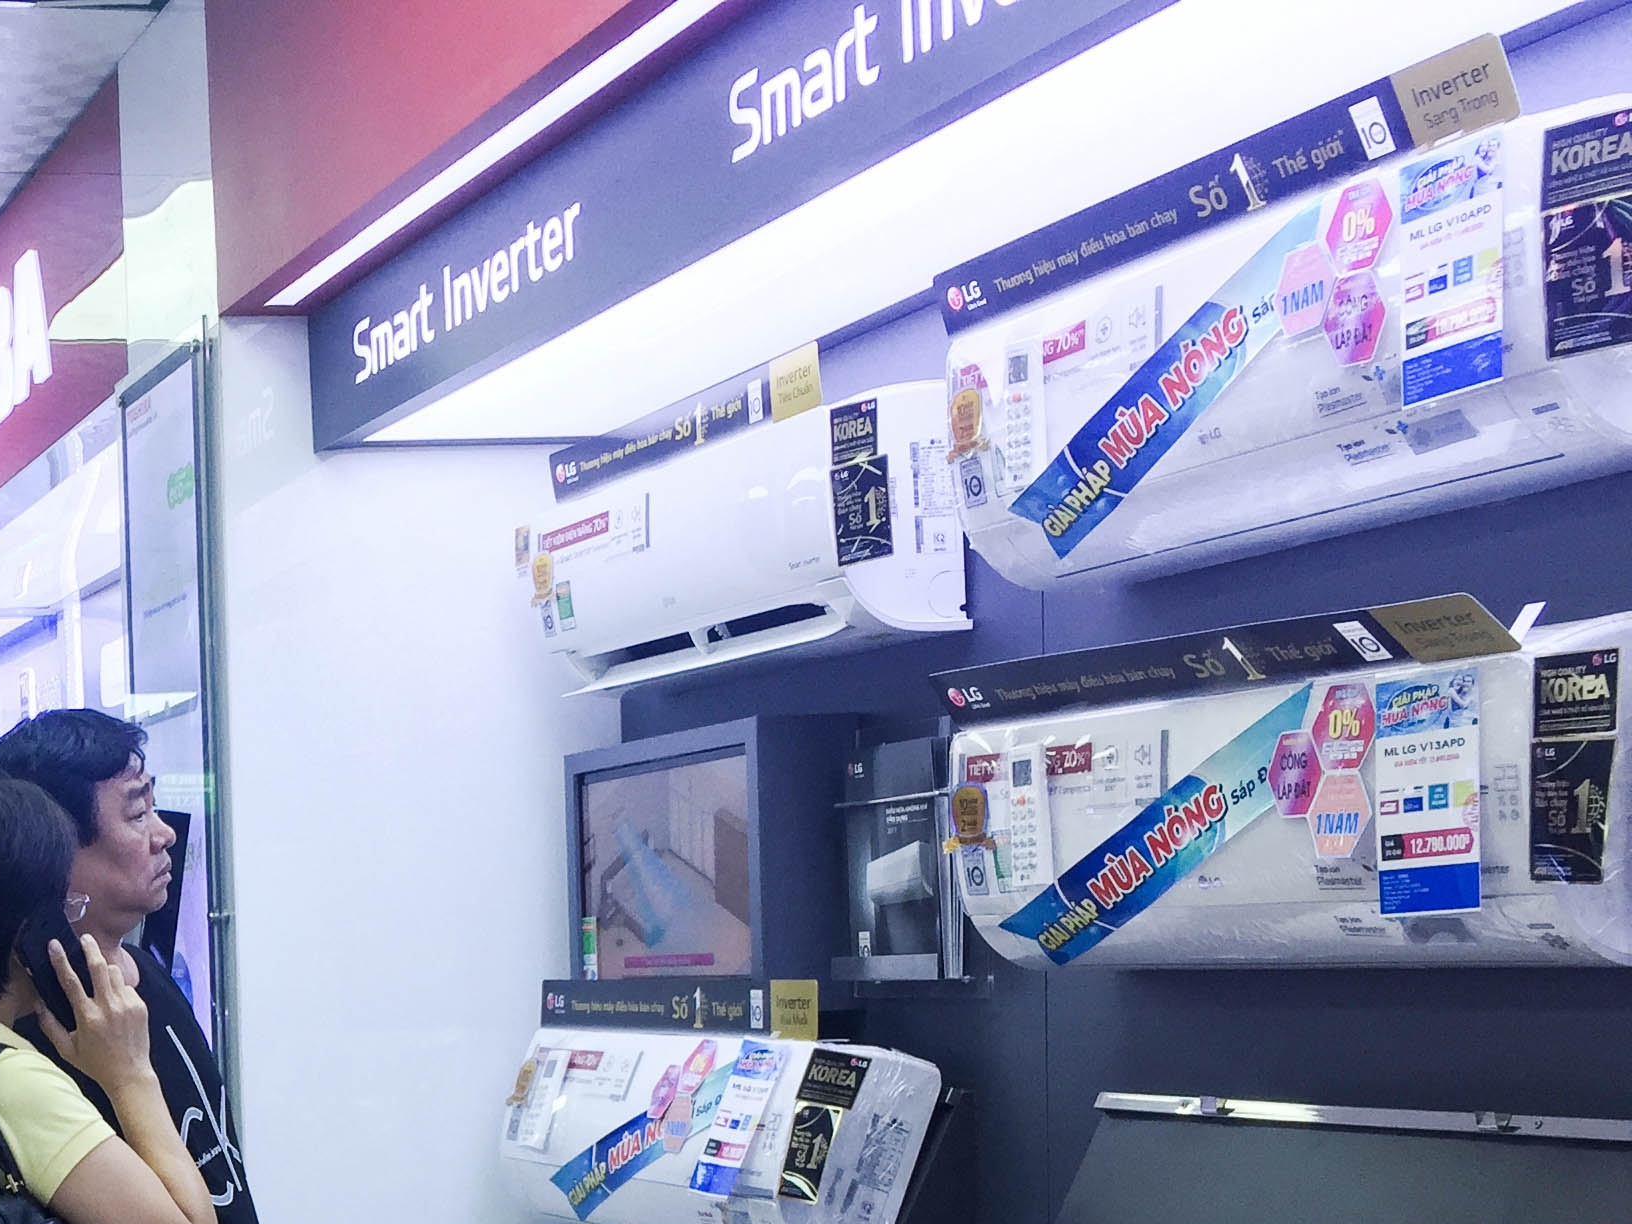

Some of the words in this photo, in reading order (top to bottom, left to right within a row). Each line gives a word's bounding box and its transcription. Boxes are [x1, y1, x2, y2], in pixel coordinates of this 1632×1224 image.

[729, 3, 881, 163] Smart
[1411, 62, 1490, 108] Inverter
[1551, 131, 1632, 176] KOREA
[1188, 171, 1228, 218] Số
[1230, 152, 1267, 212] 1
[1272, 146, 1310, 179] Thế
[1342, 204, 1376, 243] 0%
[352, 281, 436, 384] Smart
[441, 201, 581, 332] Inverter
[962, 280, 982, 302] LG
[776, 364, 813, 389] Inverter
[564, 461, 577, 477] LG
[693, 401, 706, 447] 1
[833, 416, 873, 442] KOREA
[1043, 495, 1079, 538] GIẢI
[1075, 460, 1113, 513] PHÁP
[1098, 393, 1170, 470] MÙA
[1158, 304, 1246, 412] NÓNG
[962, 686, 984, 703] LG
[1221, 636, 1267, 681] 1
[1604, 653, 1617, 664] LG
[1540, 673, 1611, 704] KOREA
[1328, 707, 1360, 740] 0%
[1384, 746, 1400, 758] ML
[1402, 743, 1417, 756] LG
[1419, 736, 1466, 753] V13APD
[1544, 747, 1556, 758] LG
[854, 762, 864, 774] LG
[1570, 778, 1592, 835] 1
[1037, 914, 1069, 951] GIẢI
[1066, 898, 1099, 932] PHÁP
[1086, 848, 1154, 909] MÙA
[1144, 782, 1229, 868] NÓNG
[554, 994, 565, 1008] LG
[671, 995, 689, 1020] Số
[693, 986, 704, 1028] 1
[808, 1064, 857, 1088] KOREA
[858, 1060, 868, 1068] LG
[607, 1127, 644, 1174] MÙA
